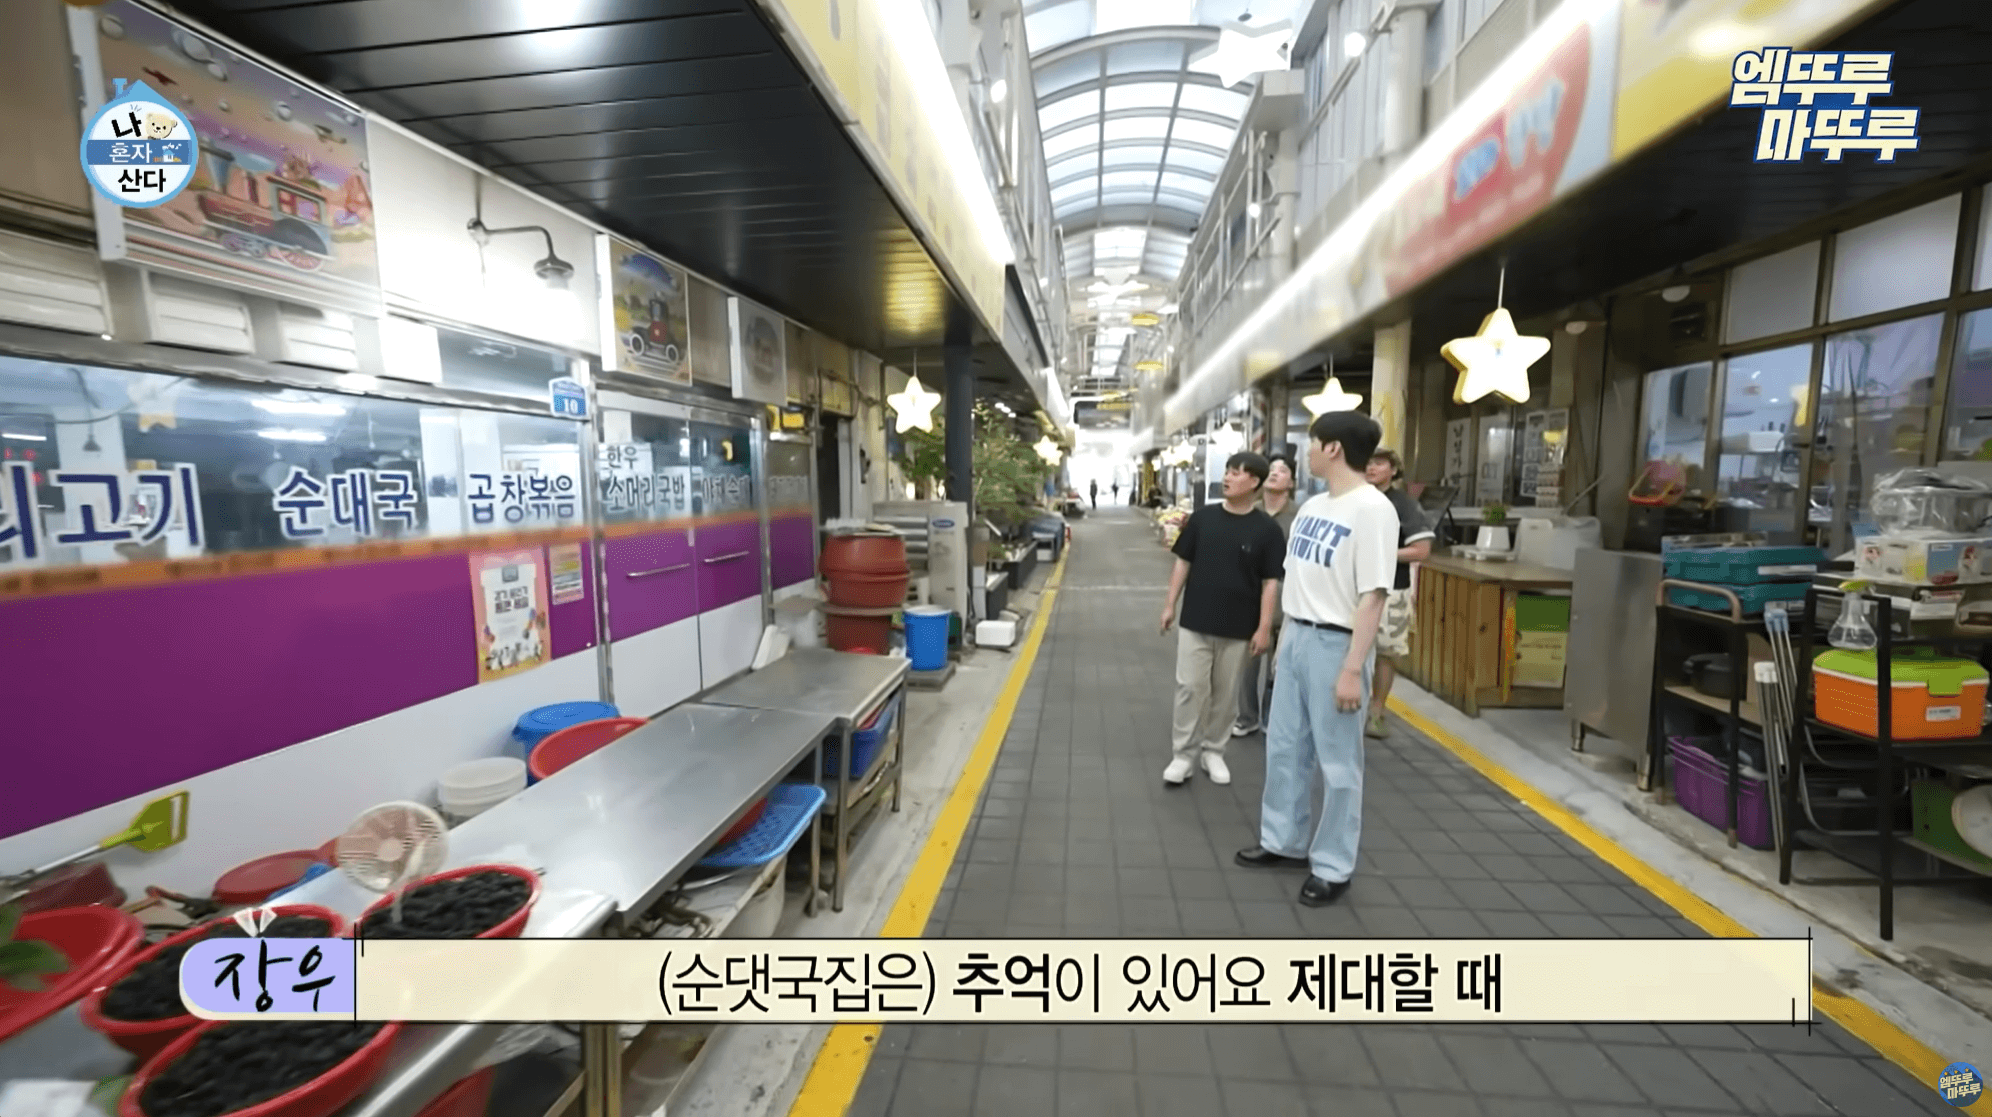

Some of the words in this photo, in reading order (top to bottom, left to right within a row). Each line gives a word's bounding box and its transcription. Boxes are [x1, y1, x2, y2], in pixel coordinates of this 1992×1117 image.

[607, 445, 638, 469] 한우
[0, 465, 200, 558] 고기
[277, 469, 416, 537] 순대국
[467, 473, 576, 525] 곱창볶음
[608, 474, 685, 511] 소머리국밥
